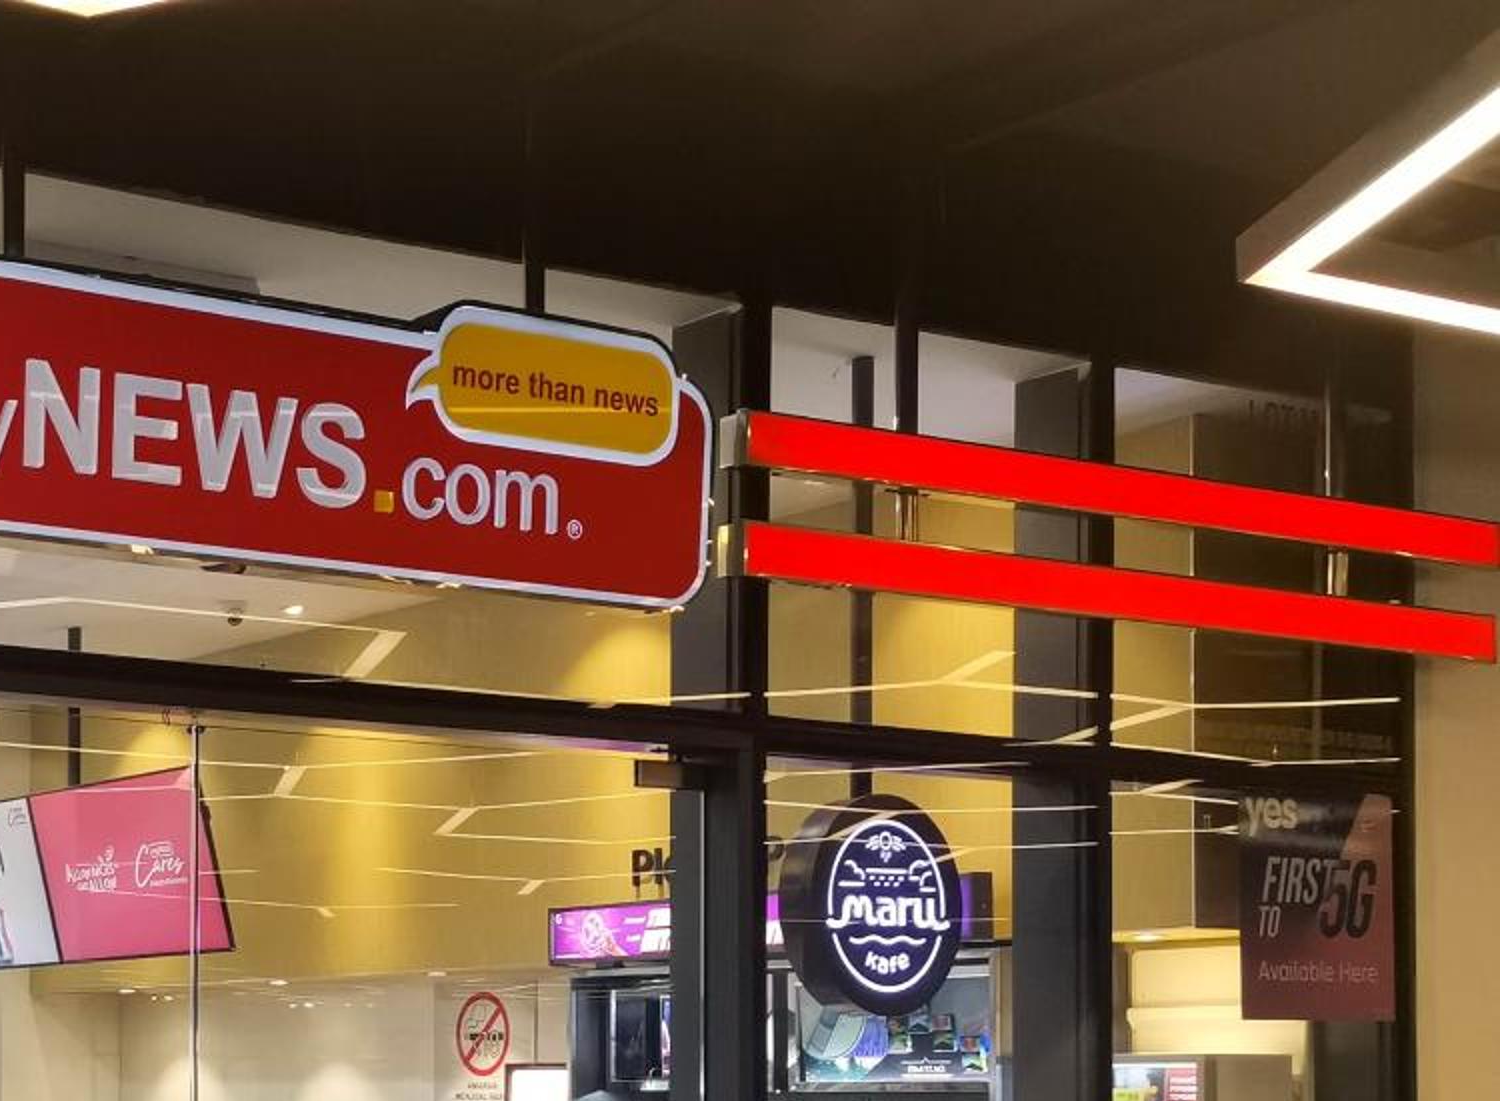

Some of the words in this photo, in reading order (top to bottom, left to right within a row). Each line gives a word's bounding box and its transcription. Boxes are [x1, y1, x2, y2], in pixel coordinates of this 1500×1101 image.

[451, 359, 520, 396] more
[528, 368, 586, 406] than
[592, 385, 659, 418] news
[1244, 797, 1298, 838] yes
[826, 894, 950, 931] maru
[1261, 856, 1334, 905] FIRST
[1318, 859, 1378, 939] 5G
[1258, 905, 1282, 938] TO
[864, 951, 911, 975] kafe
[1257, 960, 1334, 983] Available
[1339, 962, 1379, 984] Here
